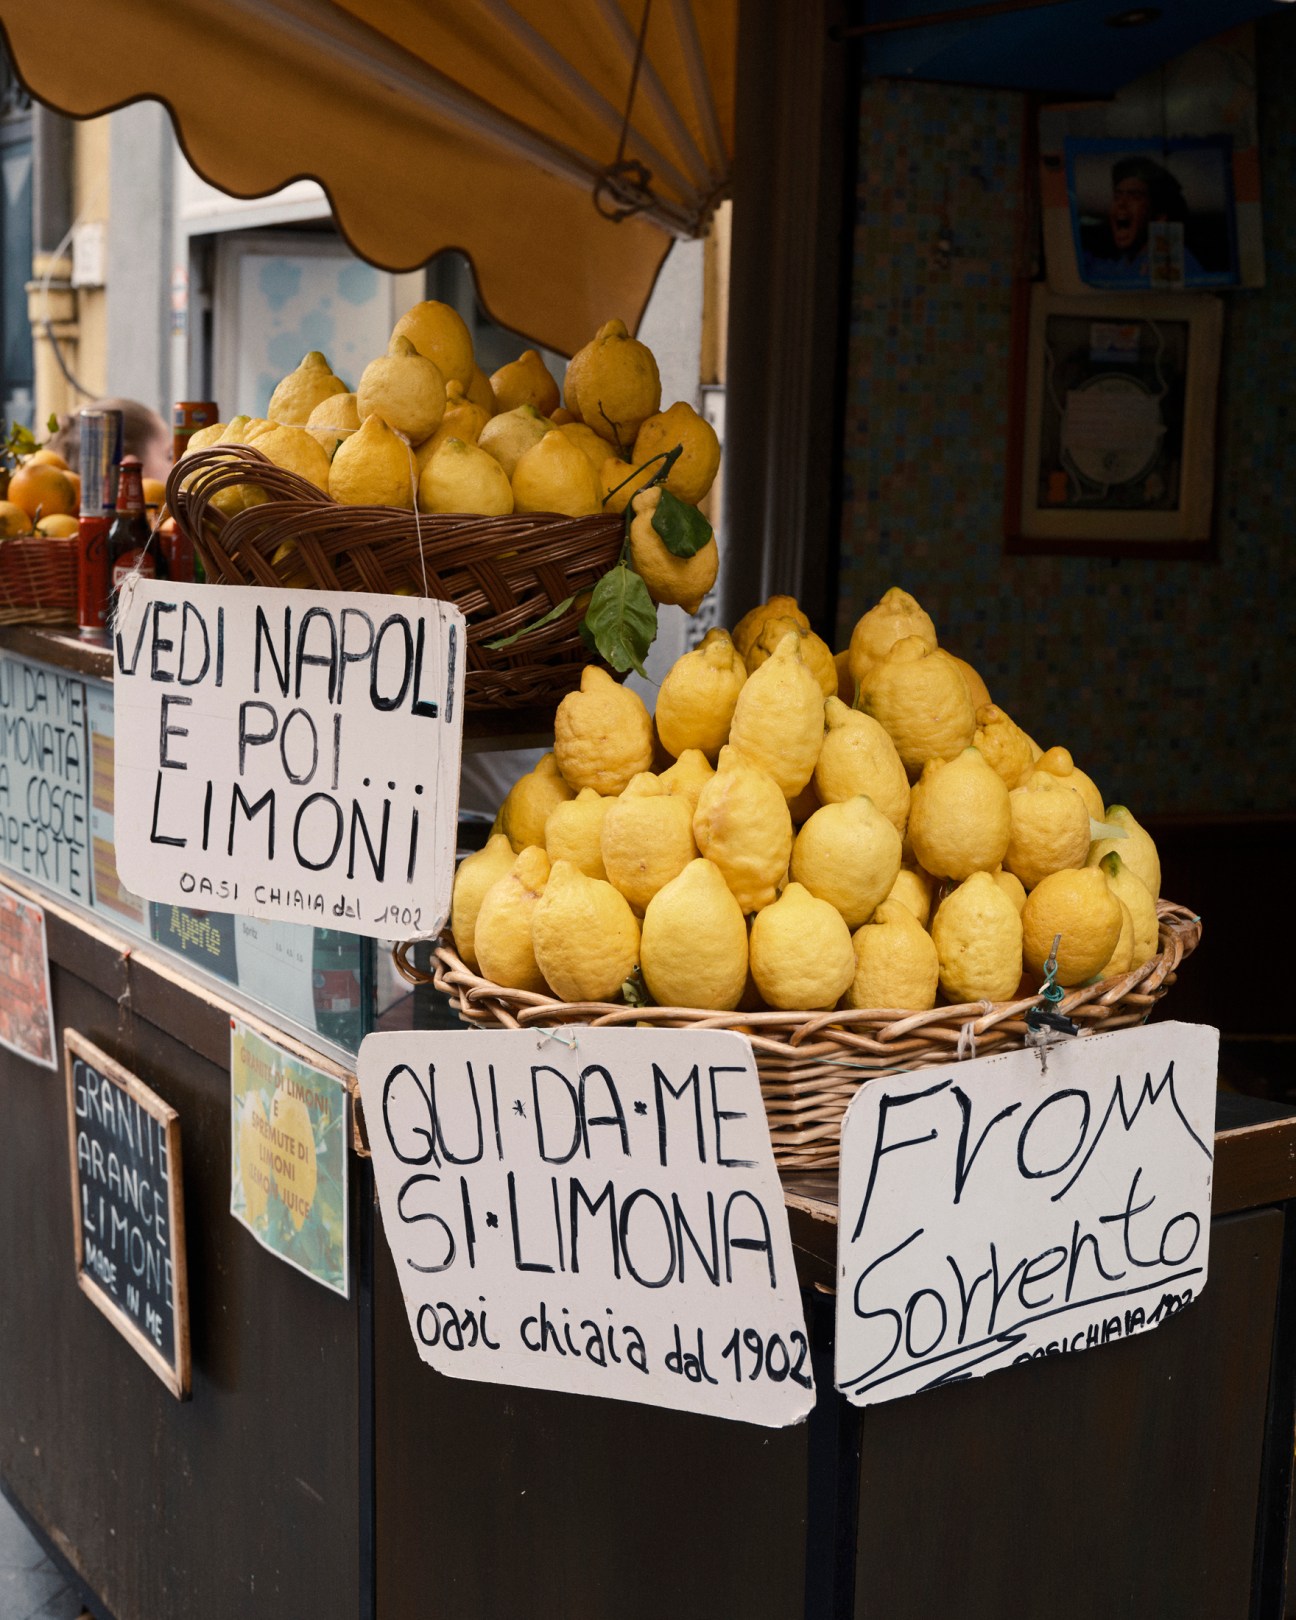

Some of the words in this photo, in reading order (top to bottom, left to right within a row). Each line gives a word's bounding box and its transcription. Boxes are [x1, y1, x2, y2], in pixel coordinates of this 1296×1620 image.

[0, 659, 15, 709] UI
[23, 663, 49, 715] DA
[55, 674, 83, 728] ME
[116, 601, 225, 687] VEDI
[254, 605, 457, 723] NAPOLI
[0, 714, 80, 785] IMONATA
[159, 693, 193, 770] E
[26, 775, 84, 848] COSCE
[179, 872, 238, 901] OASI
[254, 886, 324, 915] CHIAIA
[374, 905, 422, 931] 1902
[273, 1099, 279, 1117] E
[274, 1071, 285, 1092] DI
[286, 1078, 329, 1115] LIMONI
[251, 1110, 295, 1156] SPREMUTE
[298, 1141, 309, 1165] DI
[260, 1143, 295, 1182] LIMONI
[77, 1131, 167, 1247] ARANCE
[282, 1188, 310, 1219] JUICE
[85, 1237, 118, 1295] MADE
[127, 1282, 140, 1317] IN
[145, 1302, 163, 1347] ME
[839, 1167, 1200, 1388] Sorrento
[416, 1296, 501, 1351] oasi
[520, 1301, 649, 1374] chiaia
[665, 1323, 718, 1384] dal
[721, 1328, 813, 1389] 1902
